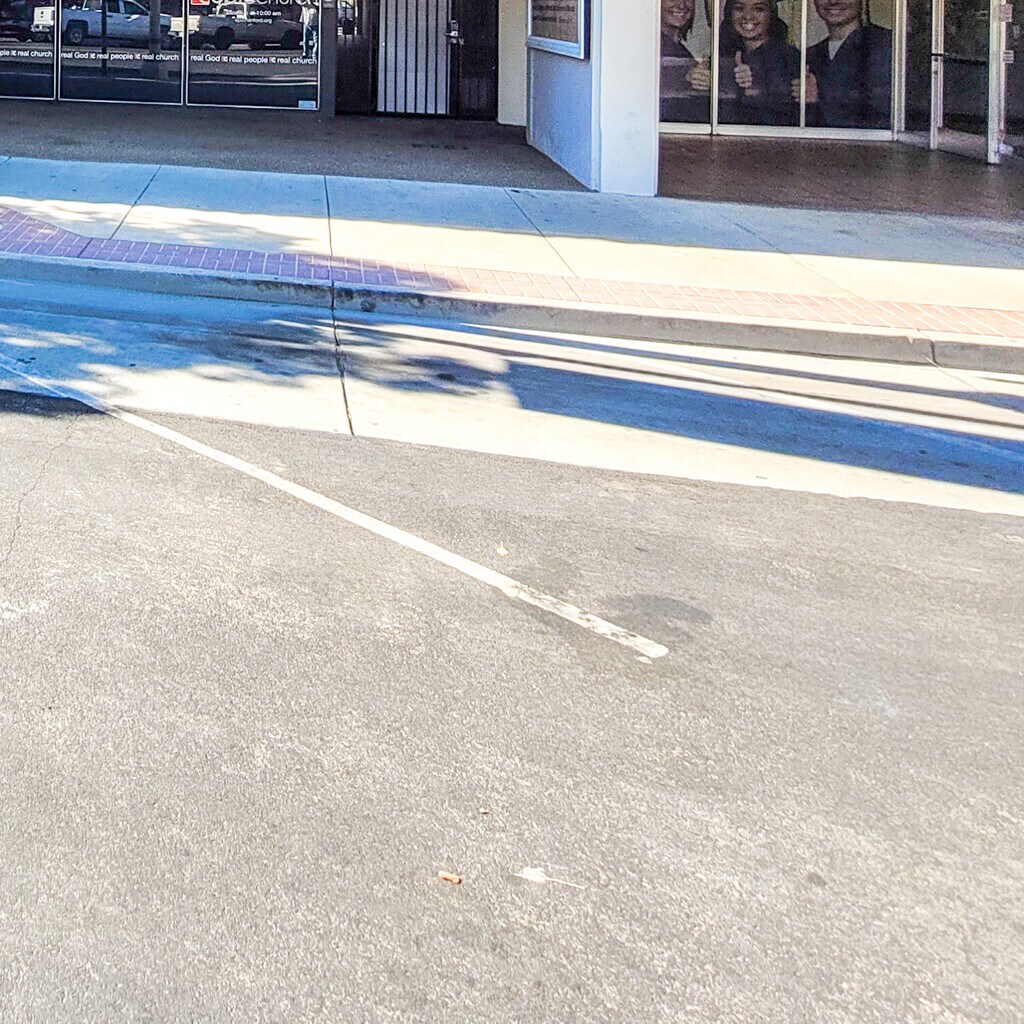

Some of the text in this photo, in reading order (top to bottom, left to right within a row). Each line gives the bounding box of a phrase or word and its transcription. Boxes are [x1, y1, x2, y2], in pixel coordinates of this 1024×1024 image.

[110, 53, 133, 61] people
[155, 53, 179, 61] church
[204, 54, 220, 62] God
[243, 56, 268, 64] people
[292, 56, 317, 64] church
